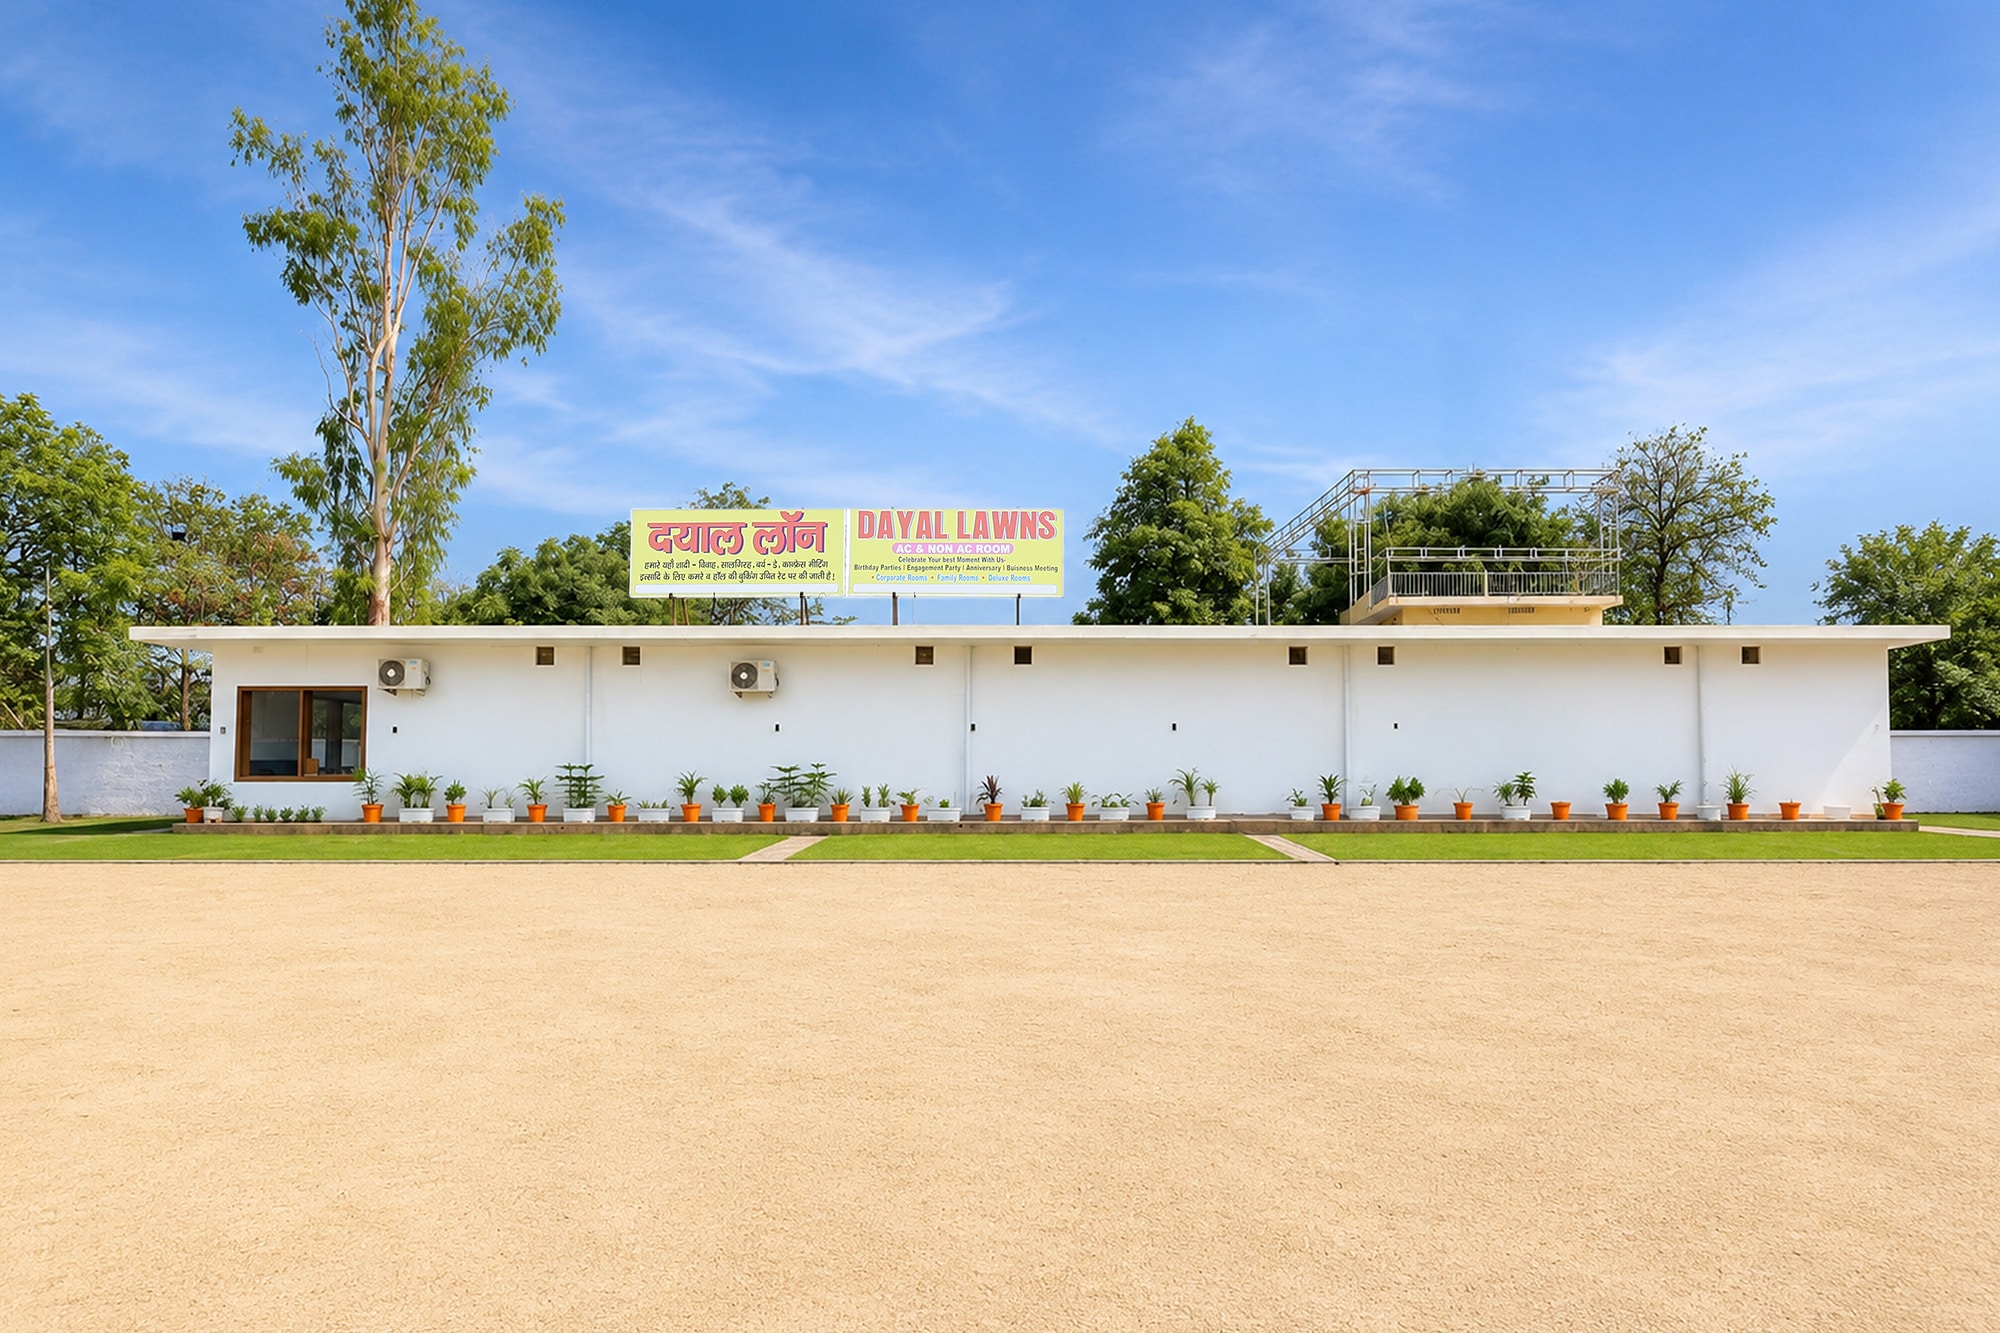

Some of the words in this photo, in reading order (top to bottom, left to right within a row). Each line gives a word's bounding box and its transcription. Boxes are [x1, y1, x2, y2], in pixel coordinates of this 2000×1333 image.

[858, 511, 949, 539] DAYAL
[957, 511, 1057, 540] LAWNS
[647, 522, 747, 555] दयाल
[752, 511, 828, 555] लॉन
[896, 544, 912, 553] AC
[916, 545, 924, 553] &
[928, 545, 953, 553] NON
[956, 544, 972, 553] AC
[976, 545, 1010, 553] ROOM
[644, 560, 660, 569] हमारे
[676, 559, 690, 568] शादी
[673, 571, 685, 580] लिए
[688, 572, 704, 580] कमरे
[728, 571, 737, 579] की
[777, 571, 786, 580] रेट
[799, 570, 807, 579] की
[809, 570, 824, 580] जाती
[876, 574, 906, 582] Corporate
